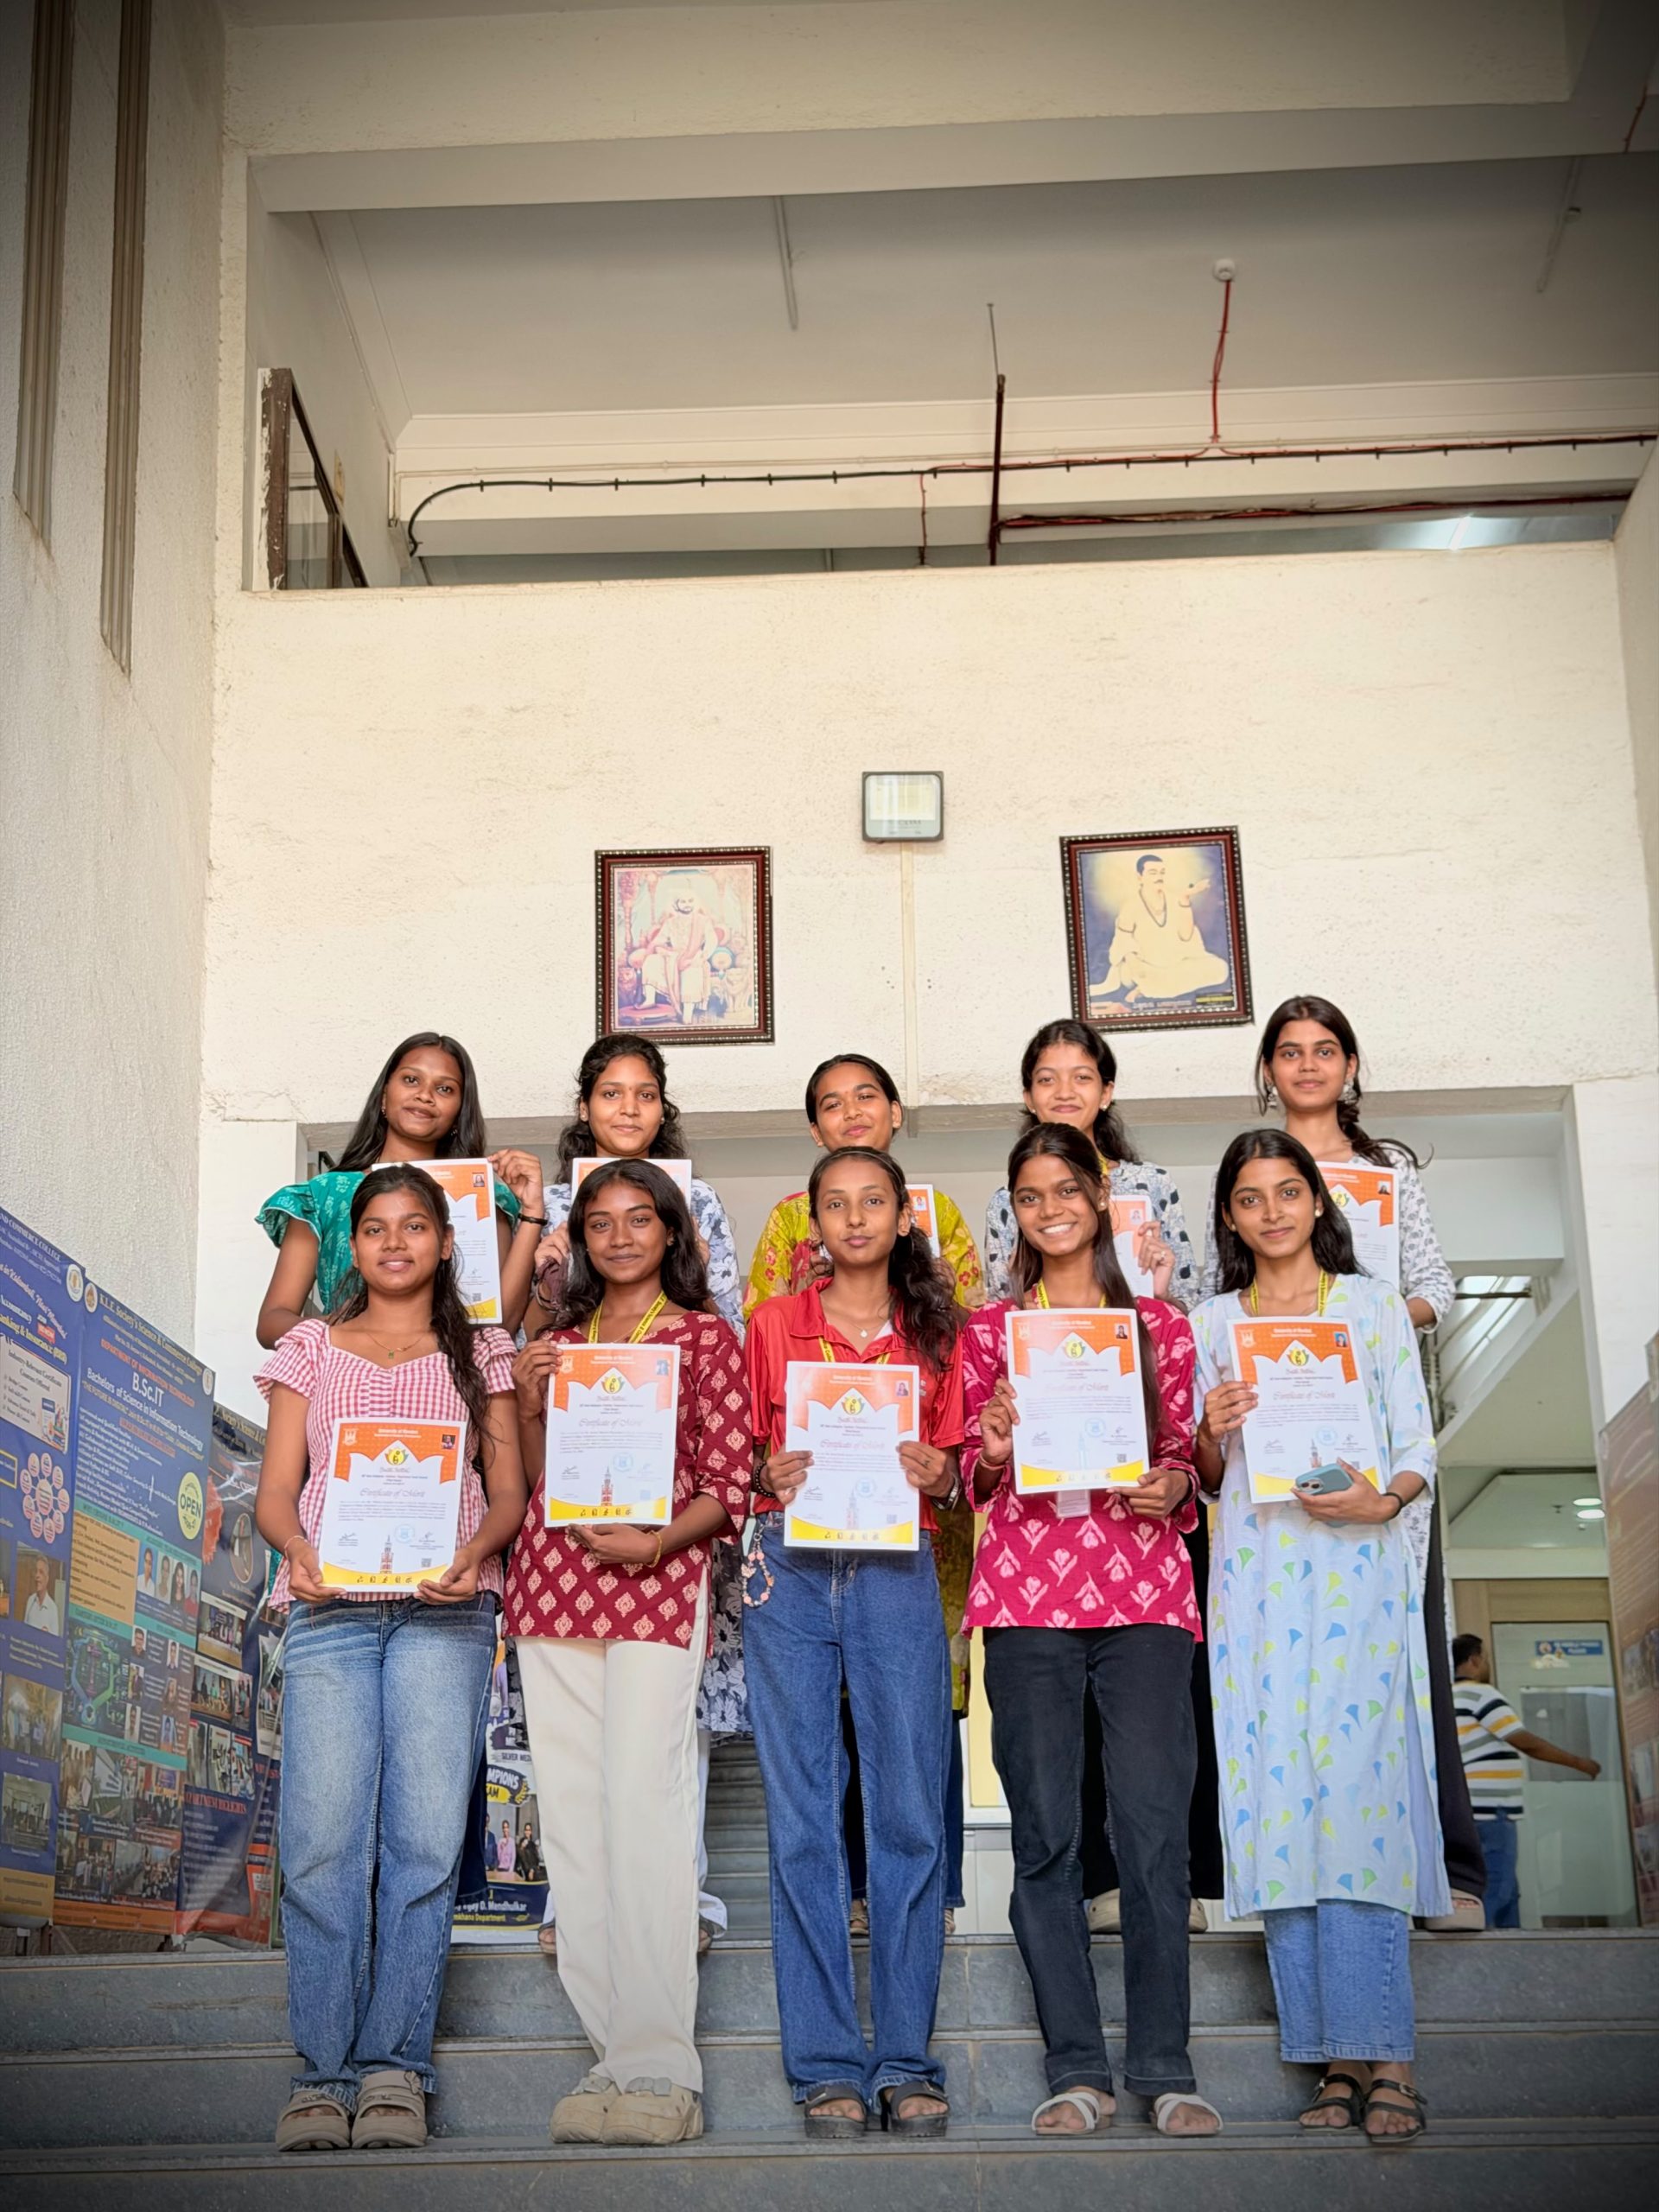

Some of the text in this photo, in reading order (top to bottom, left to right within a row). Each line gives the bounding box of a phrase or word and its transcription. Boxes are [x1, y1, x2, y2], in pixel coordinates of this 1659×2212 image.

[86, 1366, 114, 1395] Bachelors
[116, 1385, 122, 1399] of
[123, 1389, 143, 1412] Science
[149, 1405, 177, 1433] Information
[132, 1370, 164, 1409] B.Sc.IT
[180, 1494, 202, 1518] OPEN
[501, 1752, 531, 1762] SILVER MED
